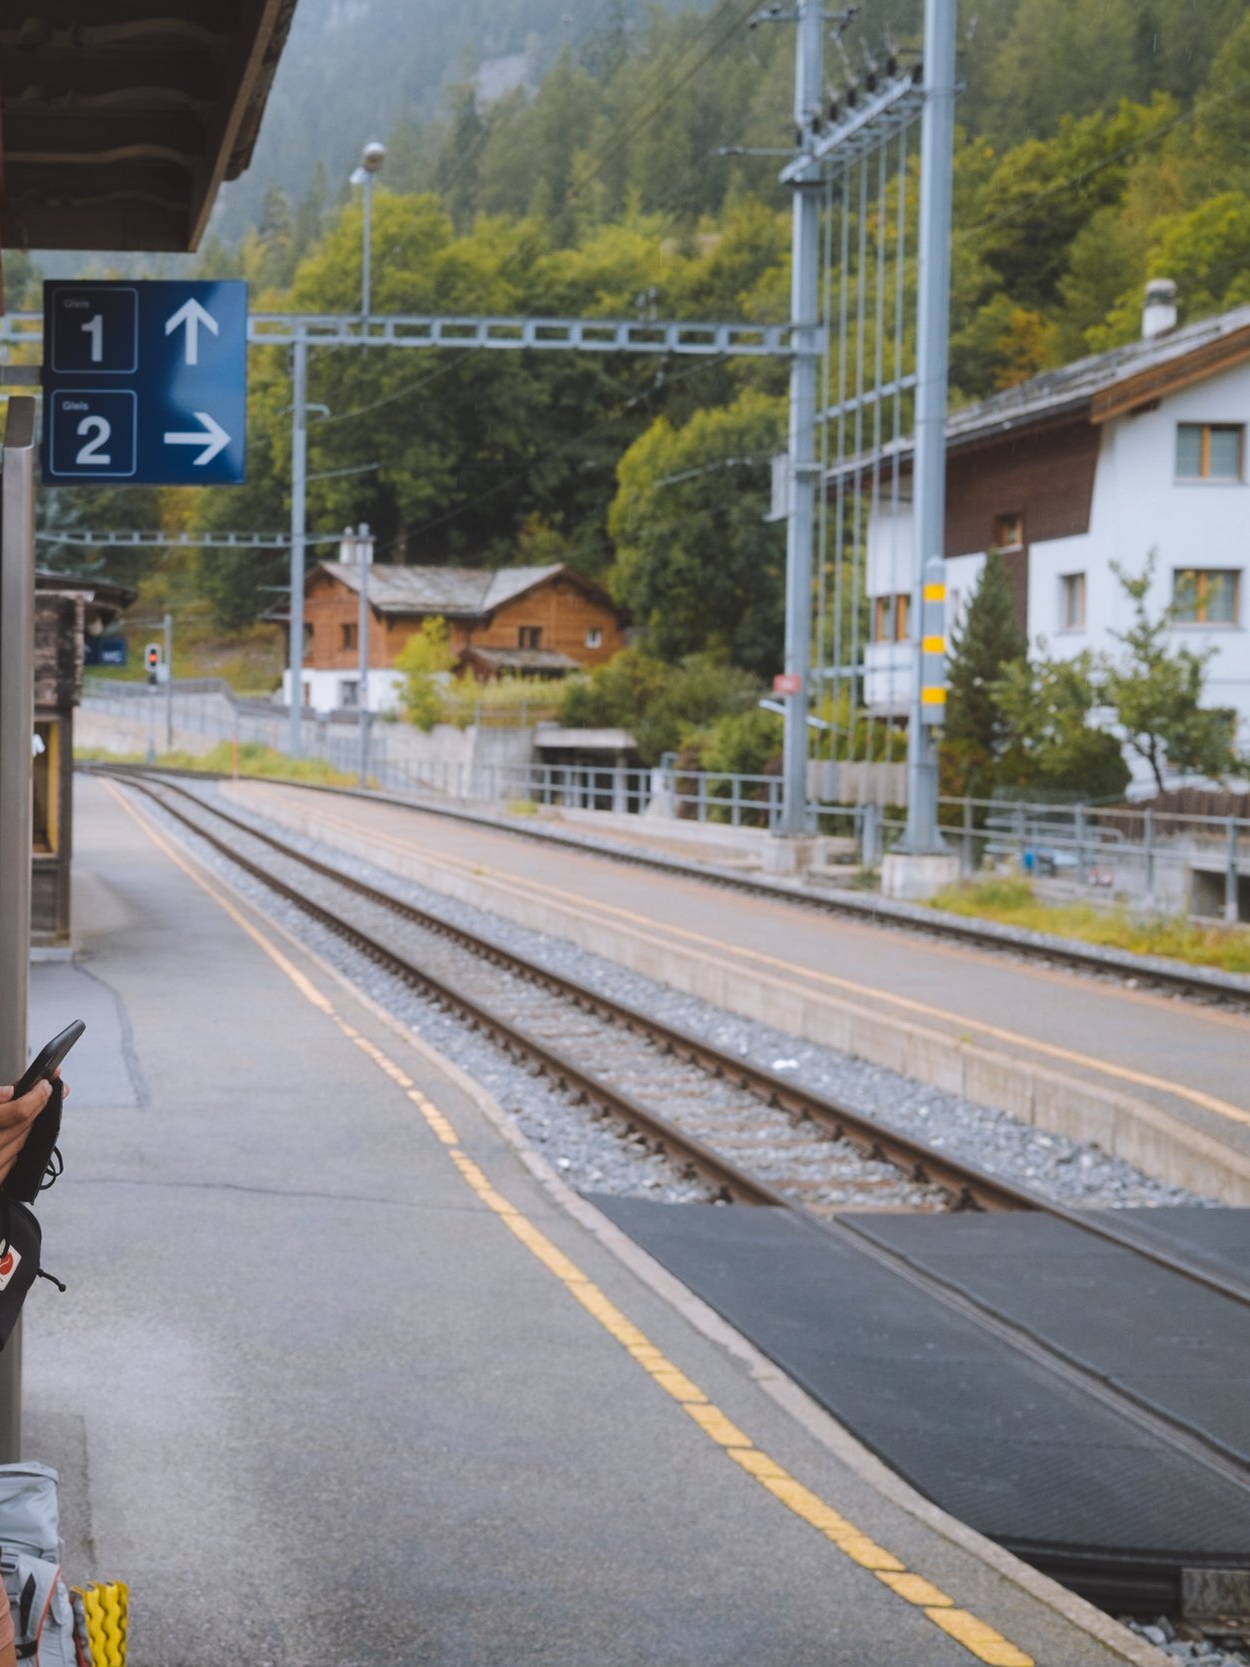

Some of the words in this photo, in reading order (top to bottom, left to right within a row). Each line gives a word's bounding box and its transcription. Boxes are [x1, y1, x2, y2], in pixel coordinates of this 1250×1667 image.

[63, 298, 90, 309] Gleis
[81, 314, 103, 362] 1
[62, 401, 89, 411] Gleis
[75, 415, 111, 464] 2
